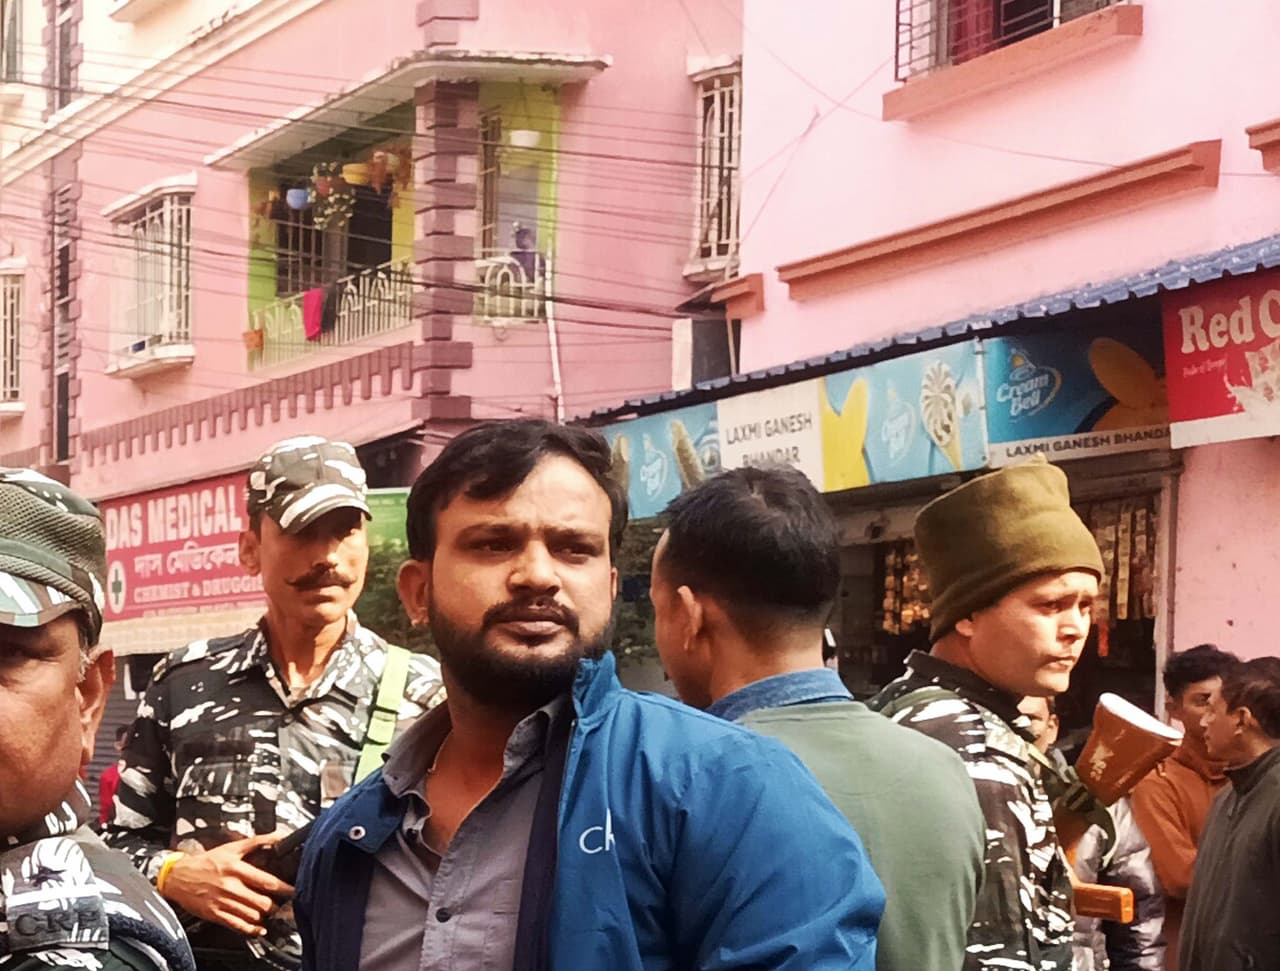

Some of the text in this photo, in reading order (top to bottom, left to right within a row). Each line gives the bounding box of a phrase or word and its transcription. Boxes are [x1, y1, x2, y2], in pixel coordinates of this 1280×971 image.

[1178, 296, 1255, 354] Red
[726, 412, 814, 446] LAXMI GANESH
[1005, 441, 1050, 458] LAXMI
[1052, 436, 1111, 452] GANESH
[105, 484, 243, 552] DAS MEDICAL
